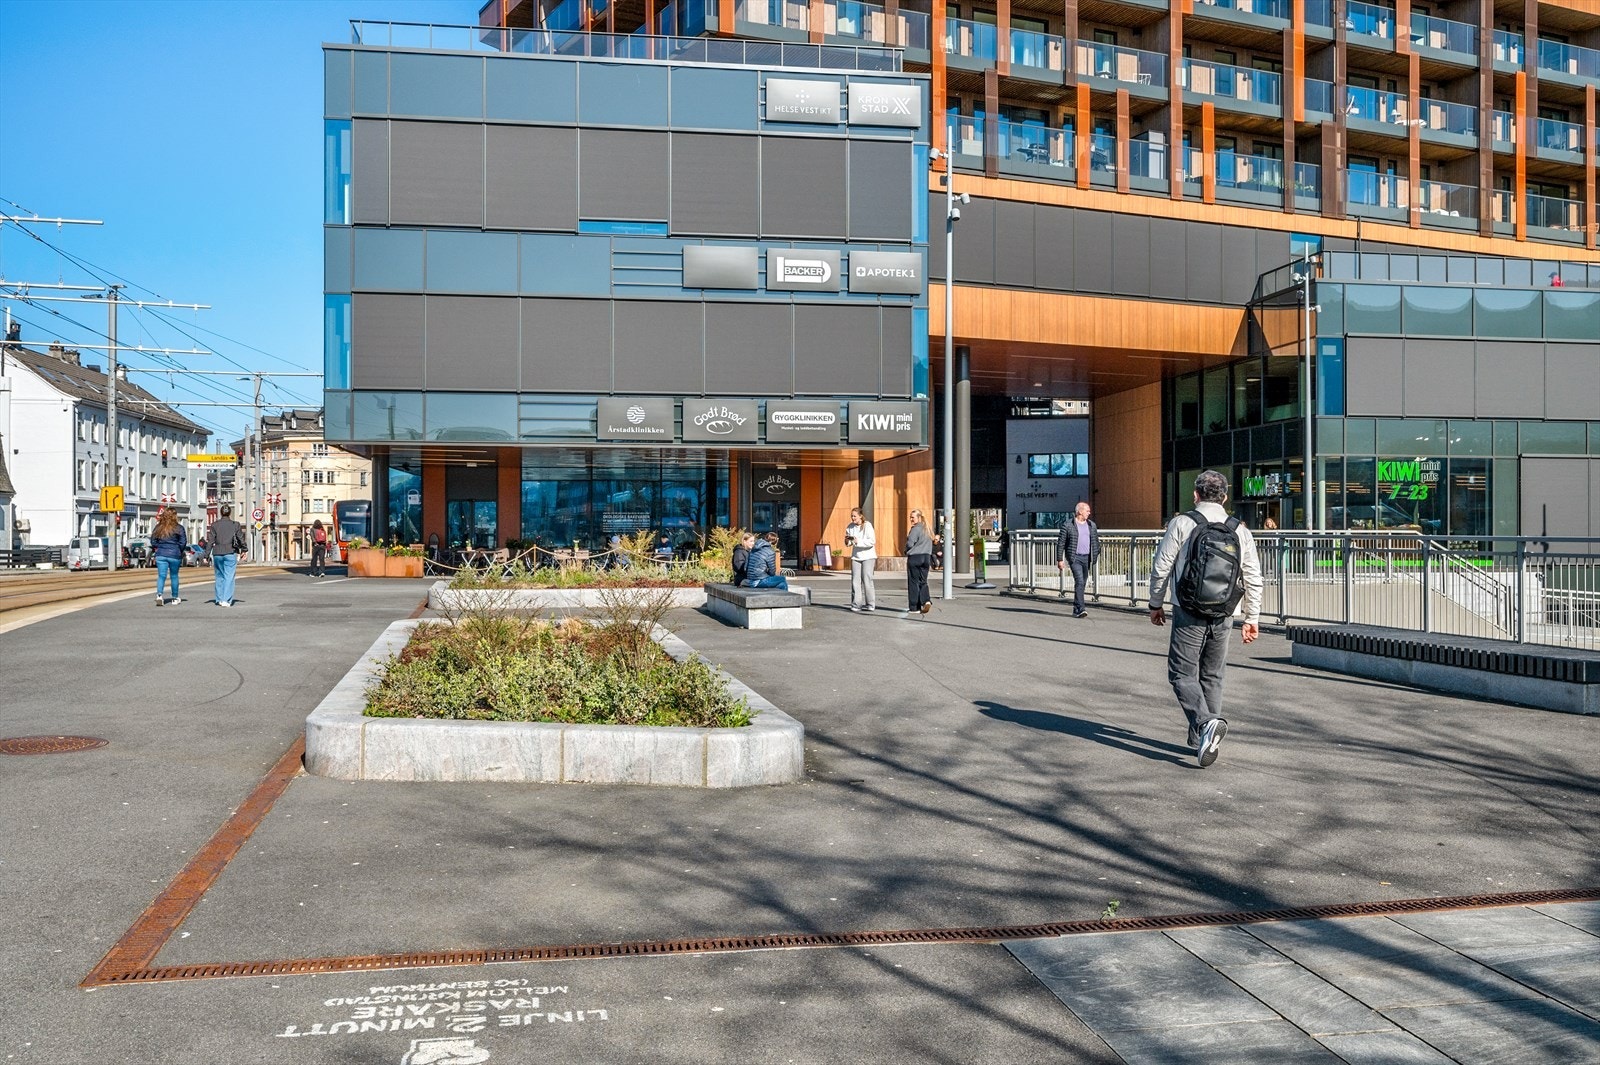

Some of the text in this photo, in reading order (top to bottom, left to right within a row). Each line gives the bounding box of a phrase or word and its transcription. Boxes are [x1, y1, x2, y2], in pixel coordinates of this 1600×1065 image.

[858, 96, 889, 104] KRON
[774, 105, 798, 113] HELSE
[800, 106, 818, 114] VEST
[861, 104, 889, 113] STAD
[784, 266, 824, 276] BACKER
[866, 268, 915, 278] APOTEK 1
[694, 406, 747, 425] Godt Brød
[857, 413, 913, 430] KIWI mini
[607, 424, 665, 433] Årstadklinikken
[896, 421, 911, 432] pris
[1378, 461, 1441, 482] KIWI mini
[1420, 471, 1440, 483] pris
[758, 475, 775, 489] Godt
[467, 985, 569, 999] MELLOM
[350, 997, 540, 1020] RASKARE
[498, 1009, 609, 1027] LINJE
[275, 1017, 436, 1038] MINUTT
